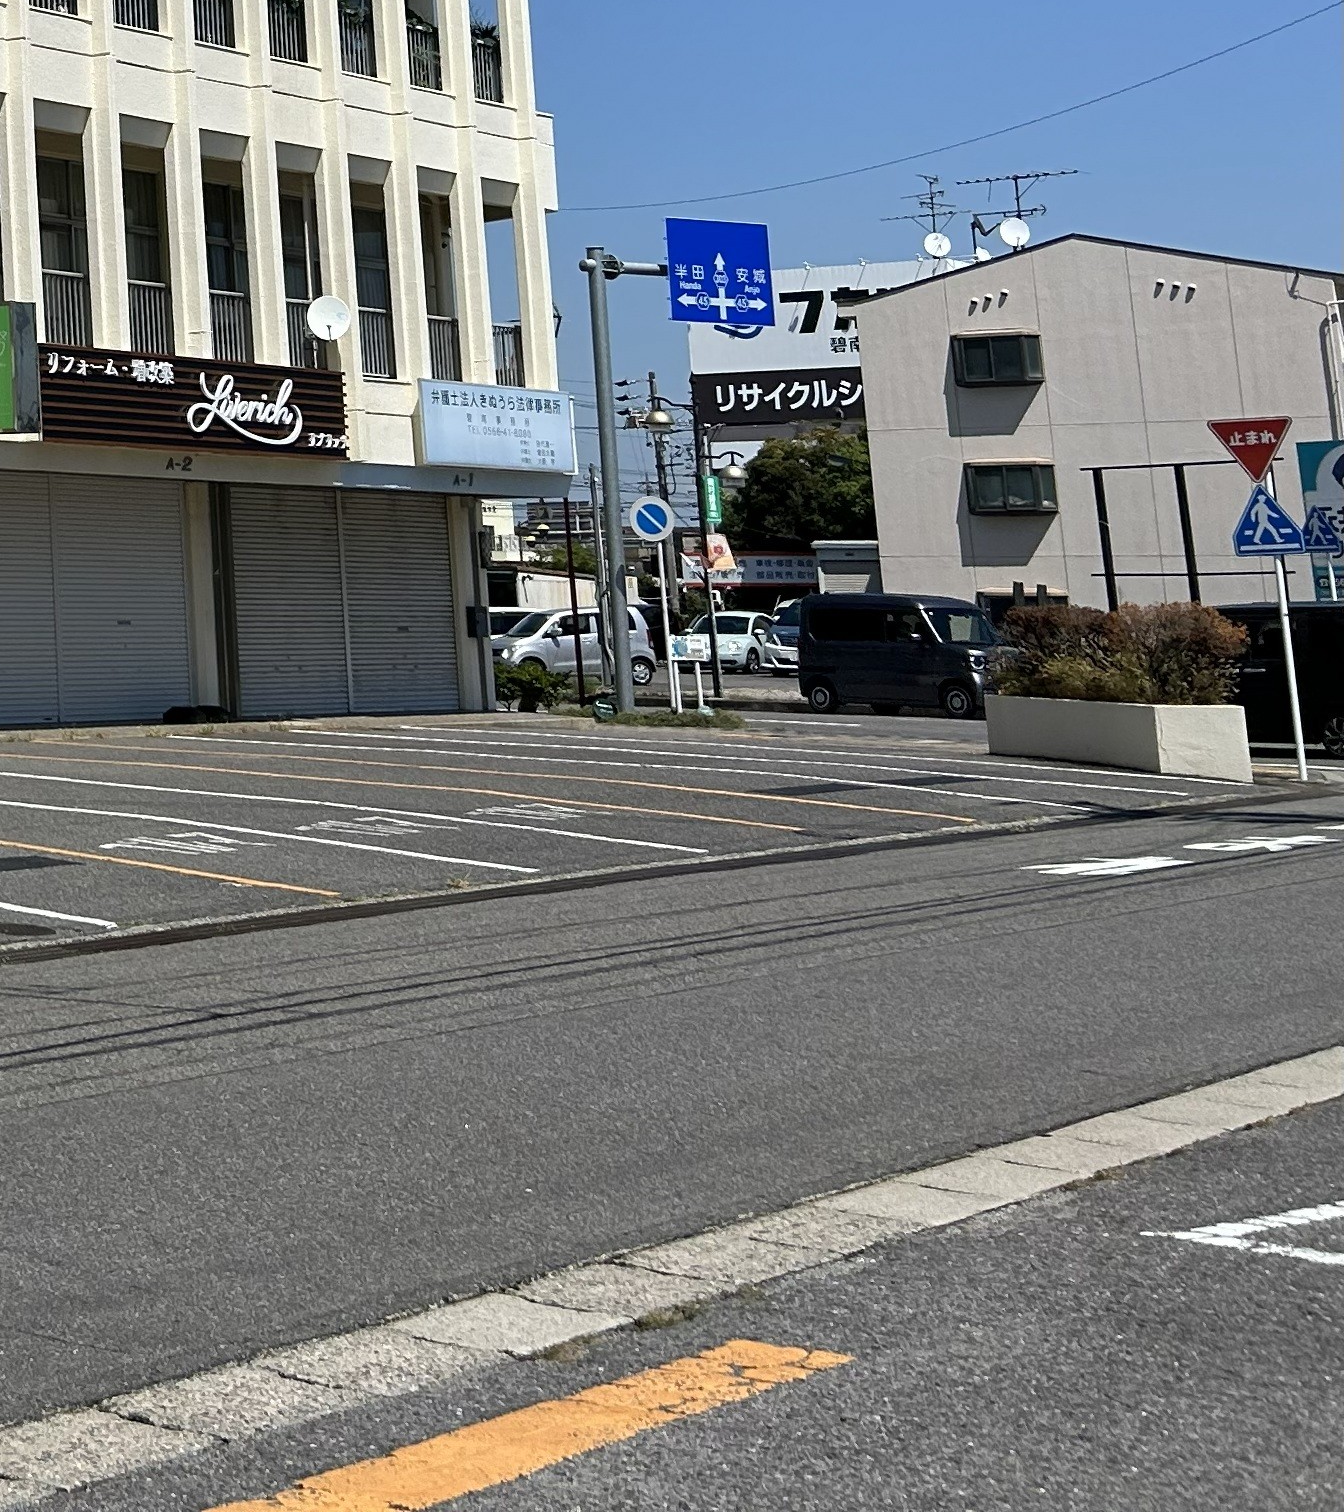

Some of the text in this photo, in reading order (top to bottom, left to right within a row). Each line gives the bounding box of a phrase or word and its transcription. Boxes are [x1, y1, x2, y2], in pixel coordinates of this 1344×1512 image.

[674, 263, 705, 280] 半田
[735, 267, 767, 284] 安城
[47, 351, 176, 386] リフォーム・増改築
[430, 388, 562, 416] 弁護士法人きぬうら法律事務所
[1228, 430, 1278, 448] 止まれ
[165, 456, 193, 472] A-2
[453, 472, 474, 487] A-1
